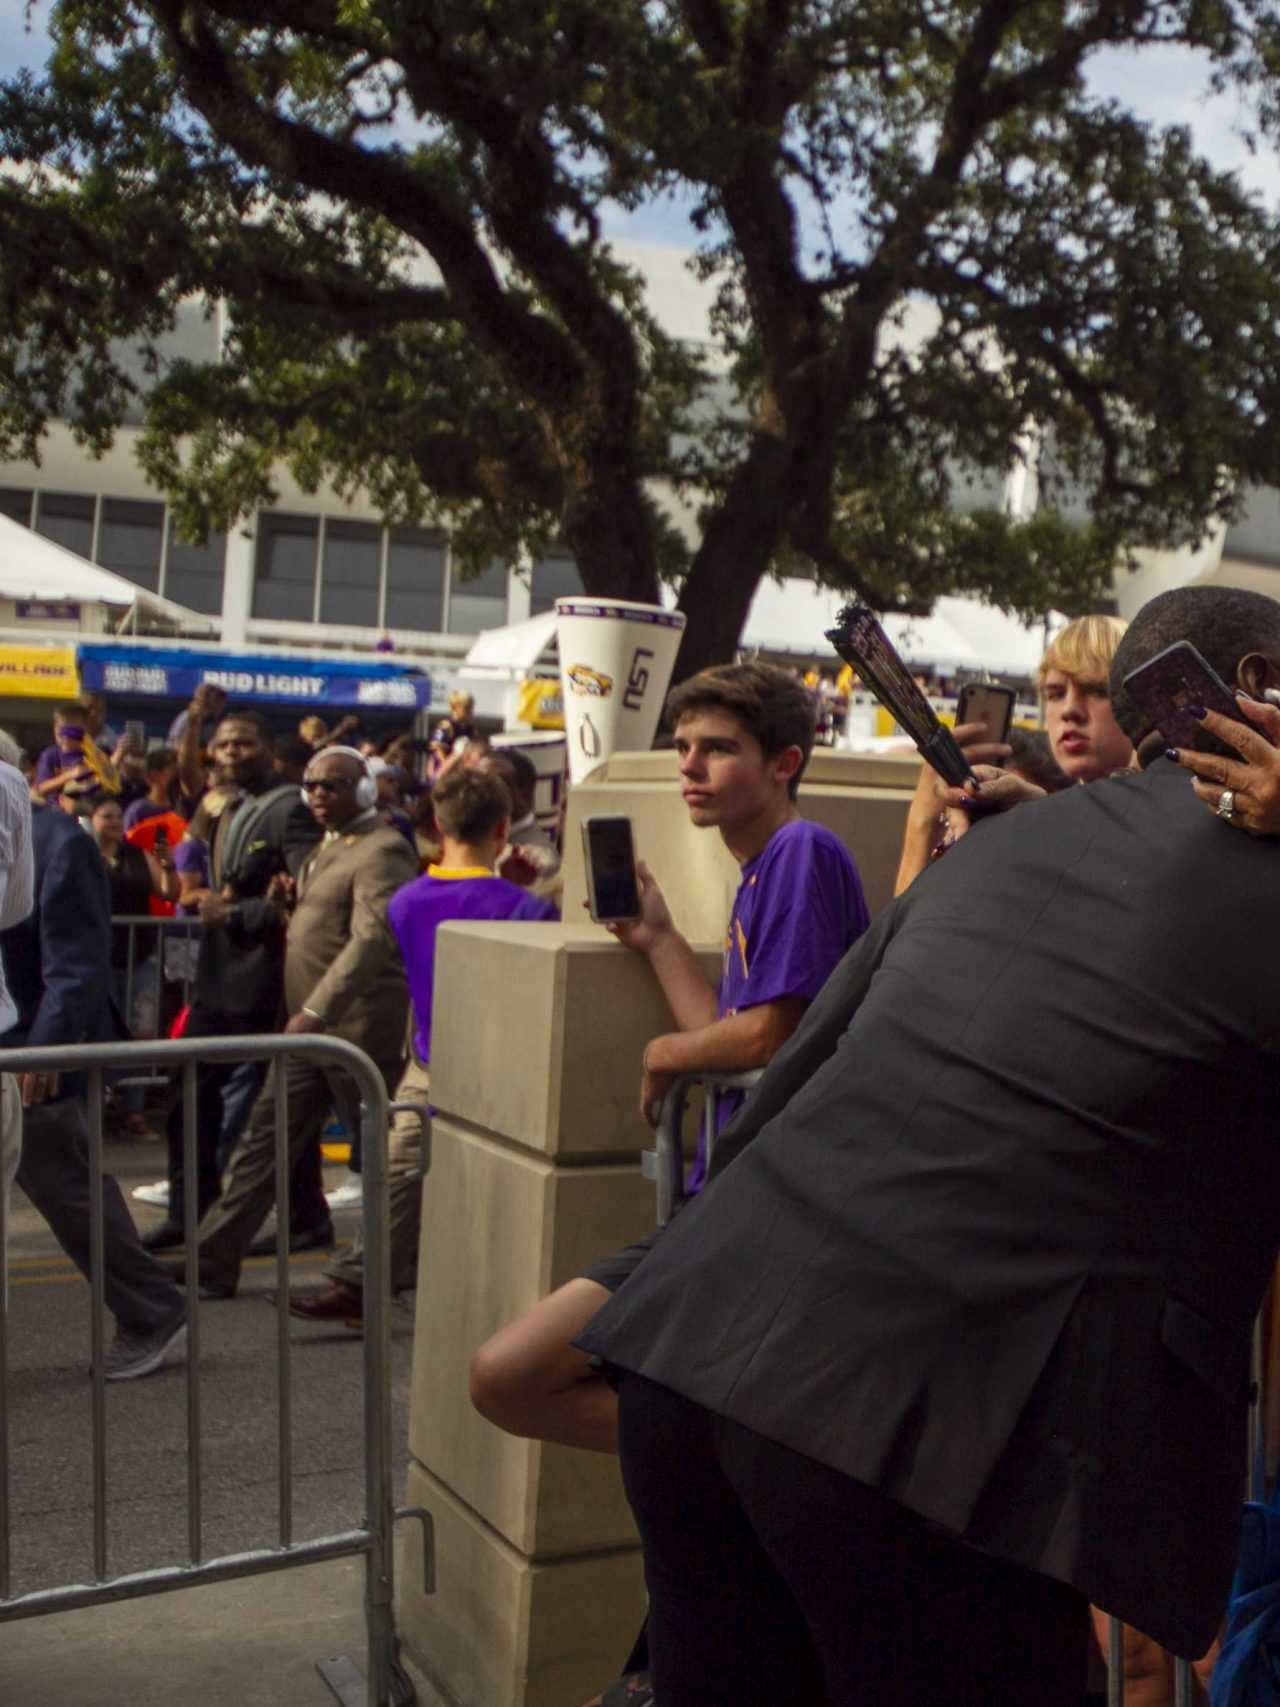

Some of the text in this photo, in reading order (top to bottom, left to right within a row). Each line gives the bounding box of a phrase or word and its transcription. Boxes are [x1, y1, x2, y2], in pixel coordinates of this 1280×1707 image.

[203, 670, 325, 697] BUD LIGHT
[623, 648, 654, 710] LSU
